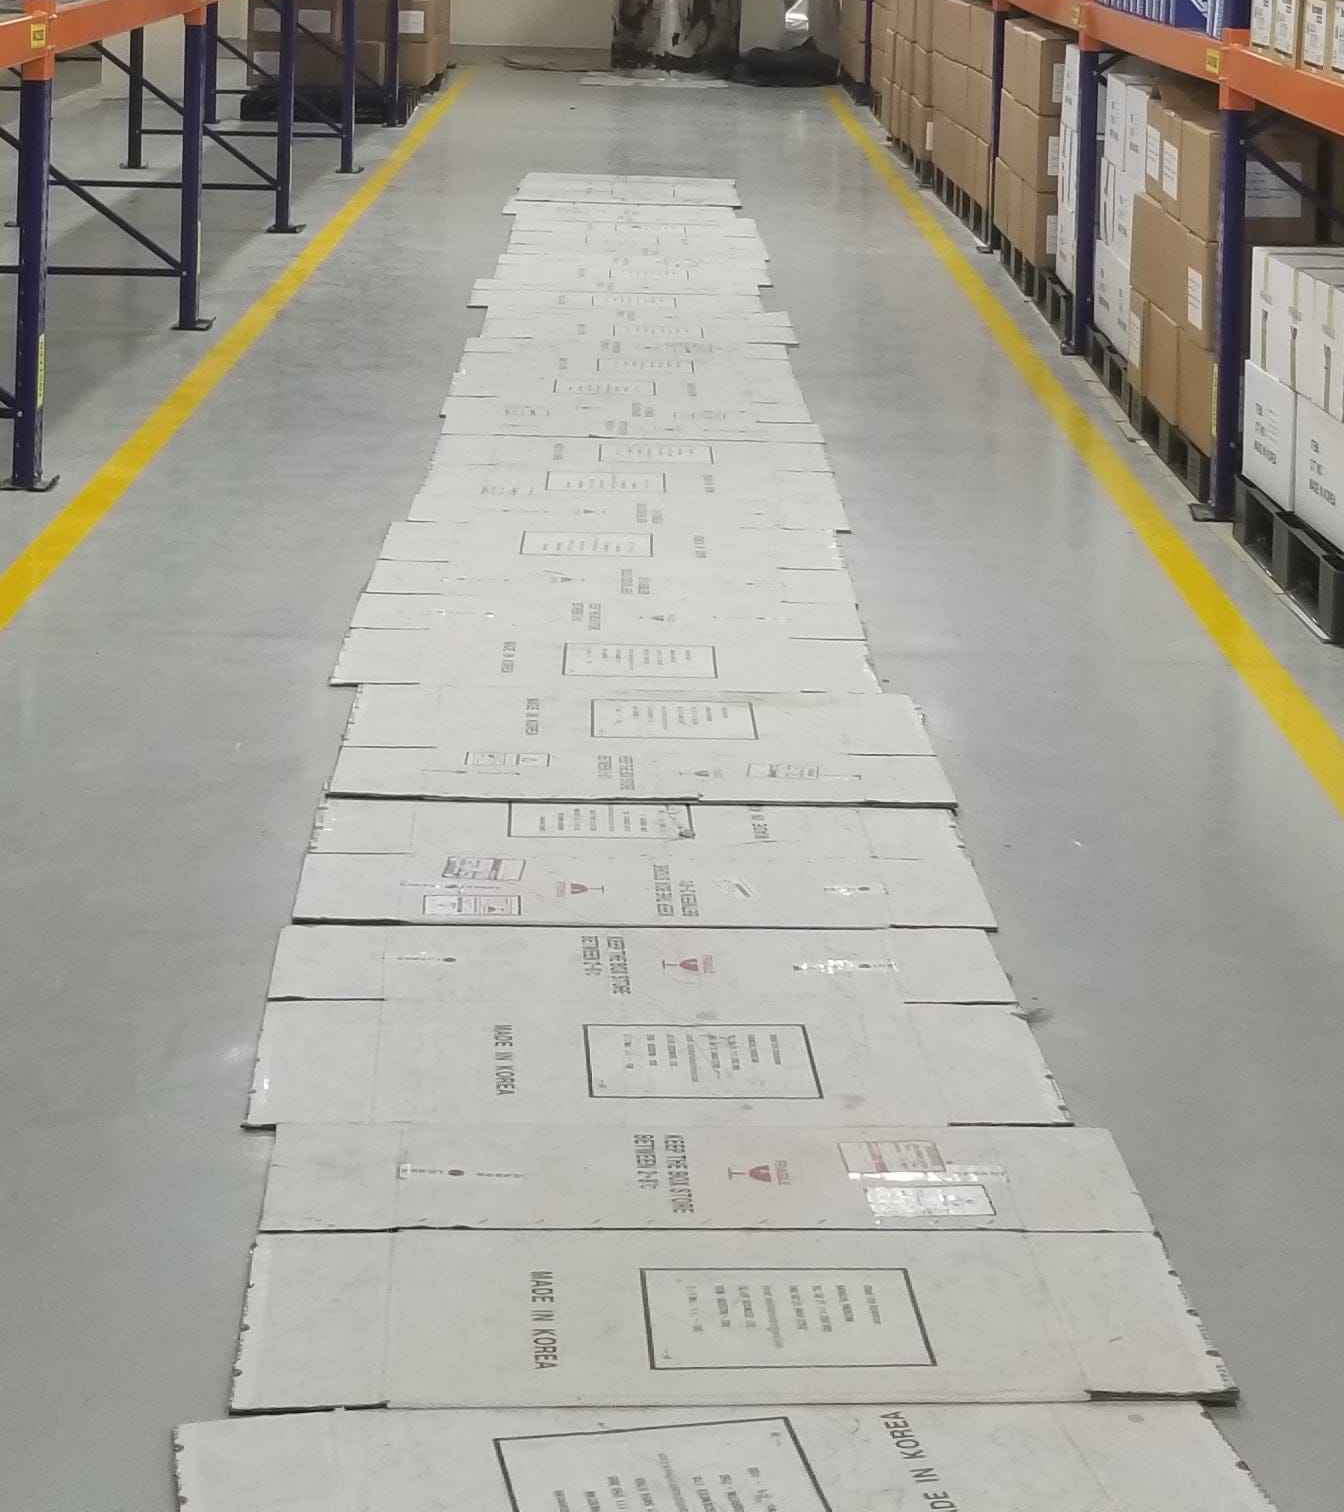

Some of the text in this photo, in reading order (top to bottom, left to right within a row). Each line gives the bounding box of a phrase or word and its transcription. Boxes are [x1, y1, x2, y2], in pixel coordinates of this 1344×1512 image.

[495, 1064, 515, 1096] KOREA
[530, 1270, 558, 1370] MADE IN KOREA
[880, 1411, 927, 1459] KOREA
[909, 1467, 940, 1483] IN
